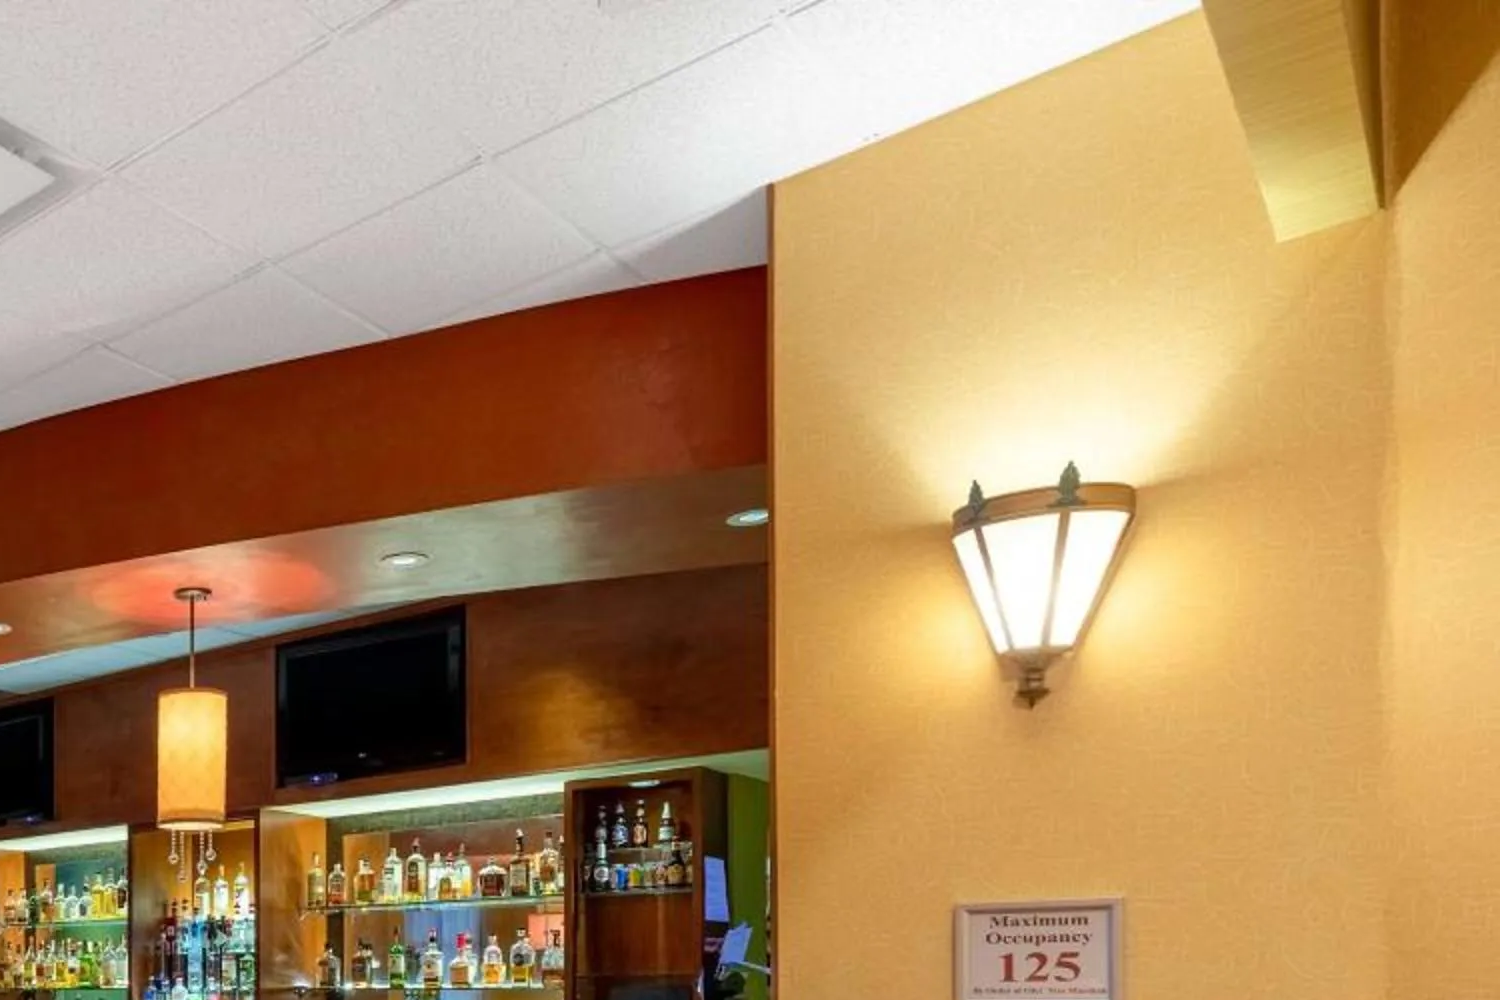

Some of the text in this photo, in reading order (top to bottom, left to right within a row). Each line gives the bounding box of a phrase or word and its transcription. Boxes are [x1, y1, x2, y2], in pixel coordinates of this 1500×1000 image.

[989, 915, 1089, 929] Maximum
[985, 931, 1093, 947] Occupancy
[999, 951, 1082, 983] 125
